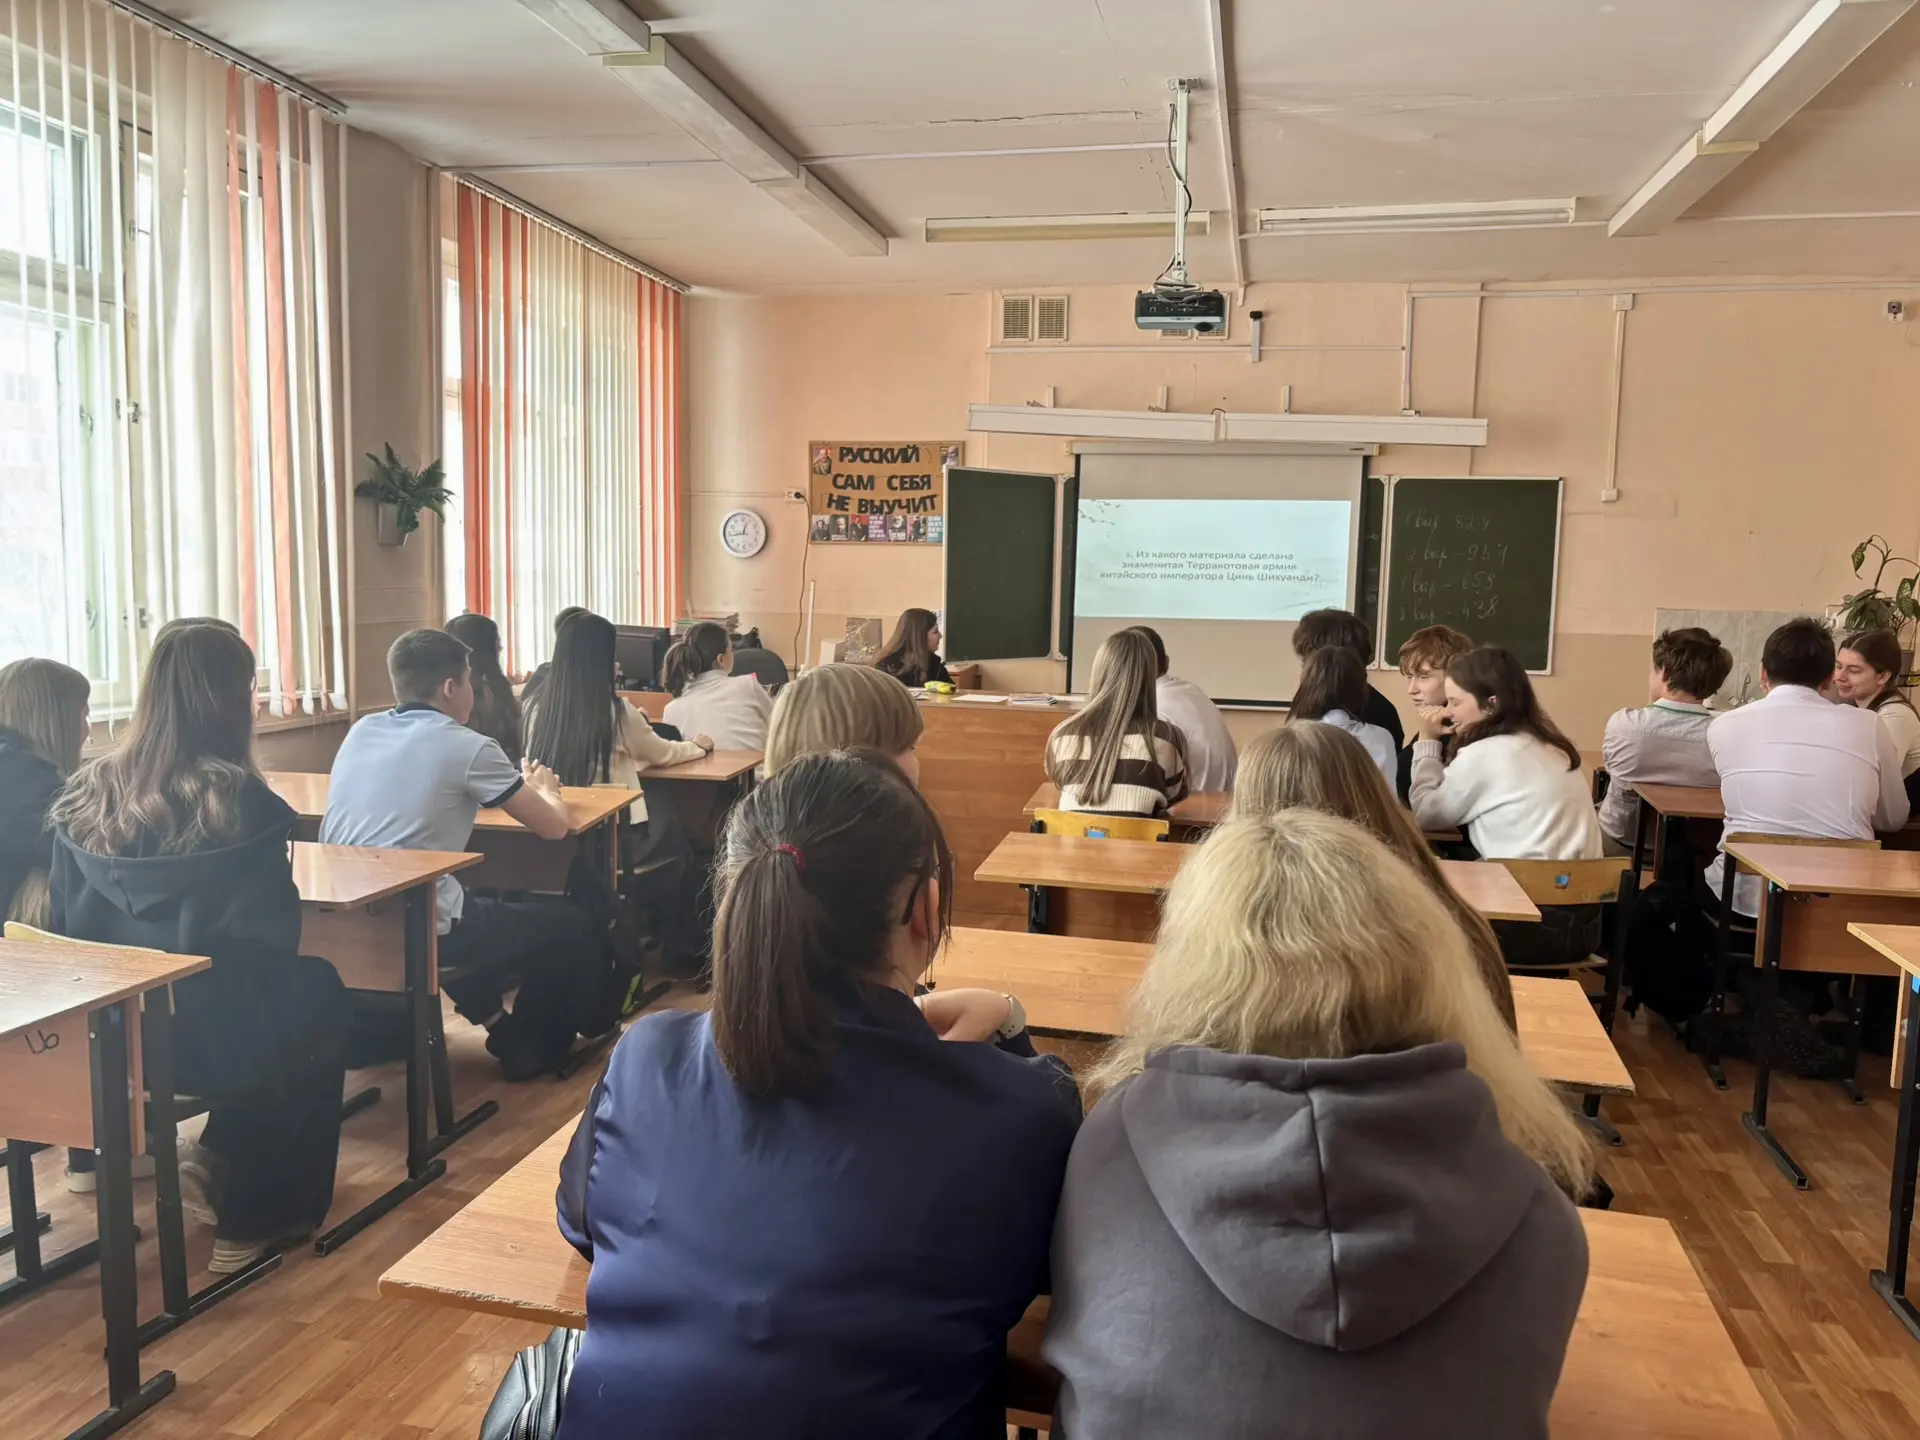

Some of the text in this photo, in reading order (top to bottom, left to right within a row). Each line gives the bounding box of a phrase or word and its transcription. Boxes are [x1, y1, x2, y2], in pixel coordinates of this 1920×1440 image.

[838, 445, 920, 464] РУССКИЙ
[832, 473, 932, 491] САМ СЕБЯ
[826, 493, 937, 515] НЕ ВЫУЧИТ
[1136, 550, 1149, 559] Из
[1189, 552, 1247, 561] материала
[1249, 553, 1294, 561] сделана
[1186, 561, 1260, 571] Терракотовая
[1262, 563, 1298, 571] армия
[1099, 570, 1320, 584] китайского императора Цинь Шихуанди?
